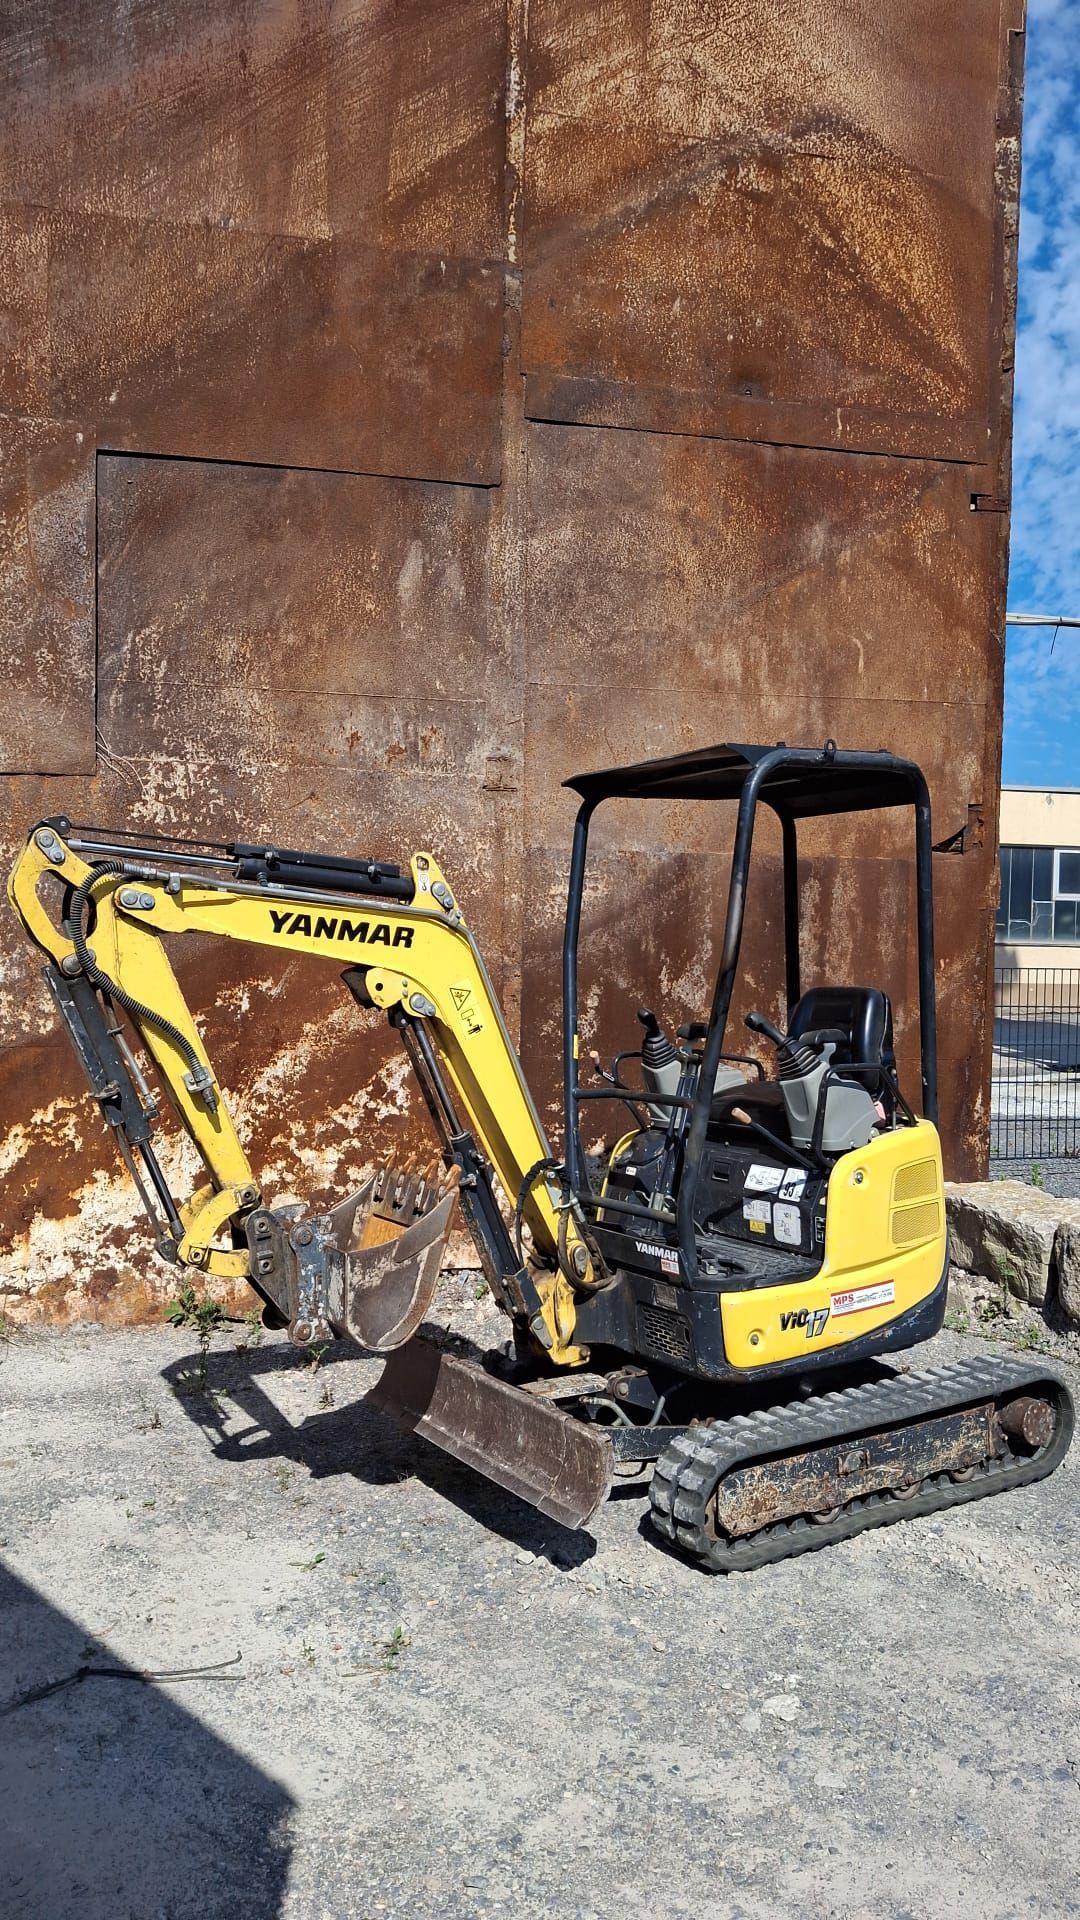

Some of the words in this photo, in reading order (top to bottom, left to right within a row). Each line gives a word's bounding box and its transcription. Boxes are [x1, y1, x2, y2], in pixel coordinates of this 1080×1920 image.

[269, 910, 415, 948] YANMAR
[783, 1182, 796, 1197] 93
[635, 1241, 679, 1261] YANMAR
[833, 1294, 855, 1306] MPS
